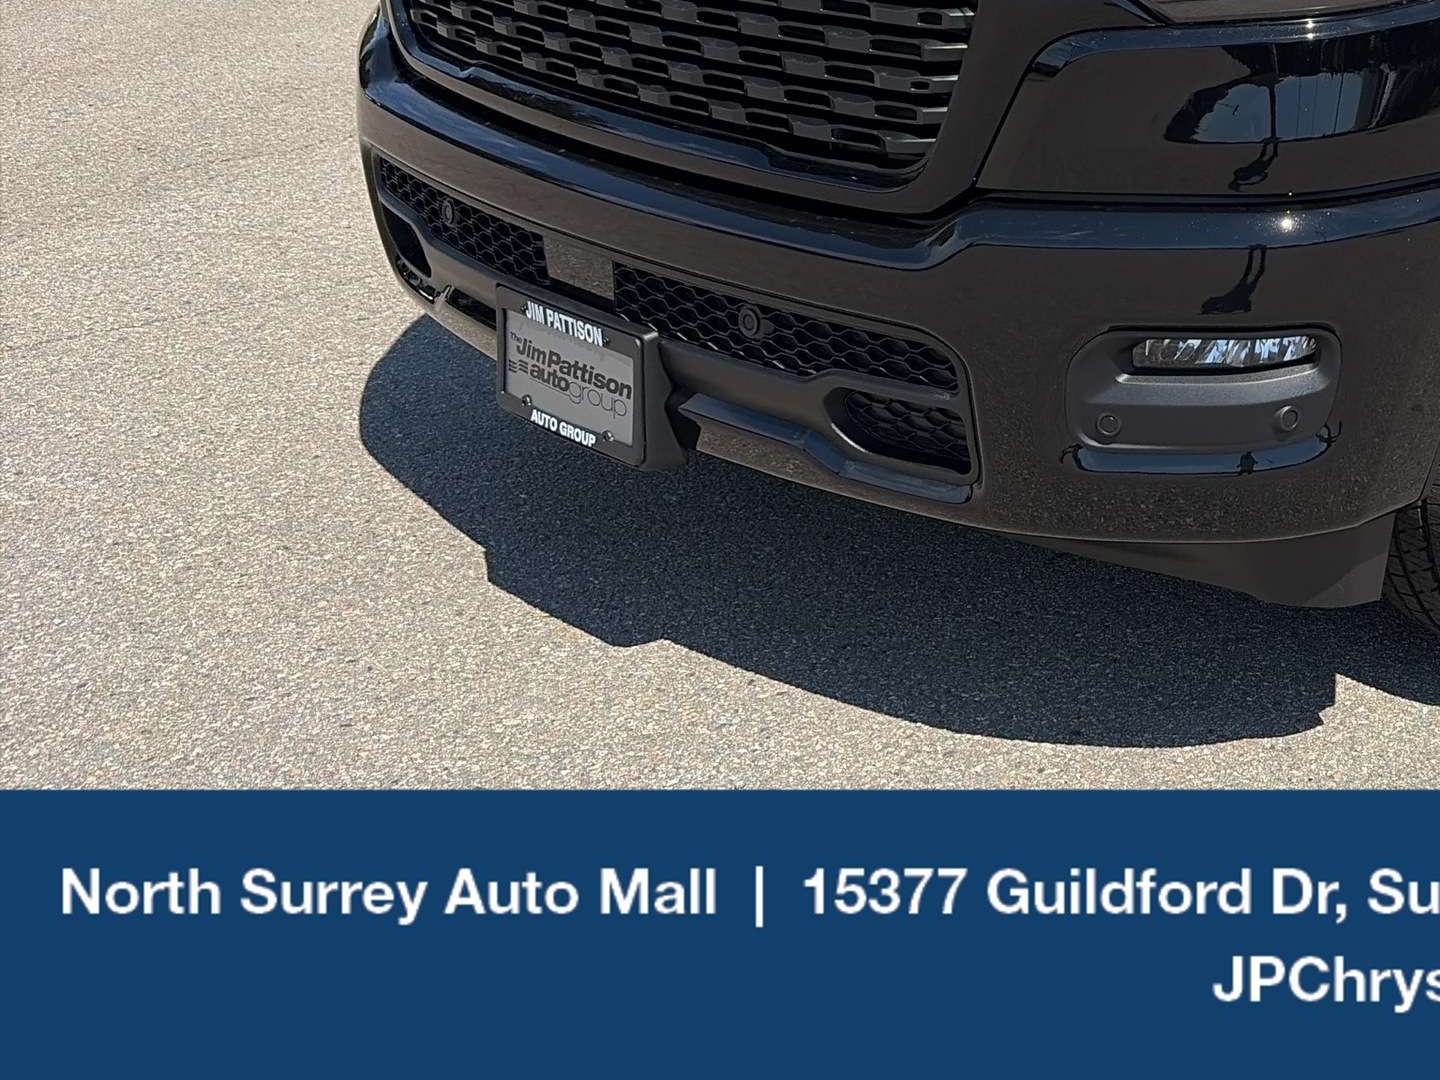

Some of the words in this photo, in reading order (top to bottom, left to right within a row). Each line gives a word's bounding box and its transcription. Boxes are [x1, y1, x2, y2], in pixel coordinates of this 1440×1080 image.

[525, 300, 546, 325] JIM
[545, 308, 604, 347] PATTISON
[530, 409, 558, 431] AUTO
[559, 421, 597, 447] GROUP
